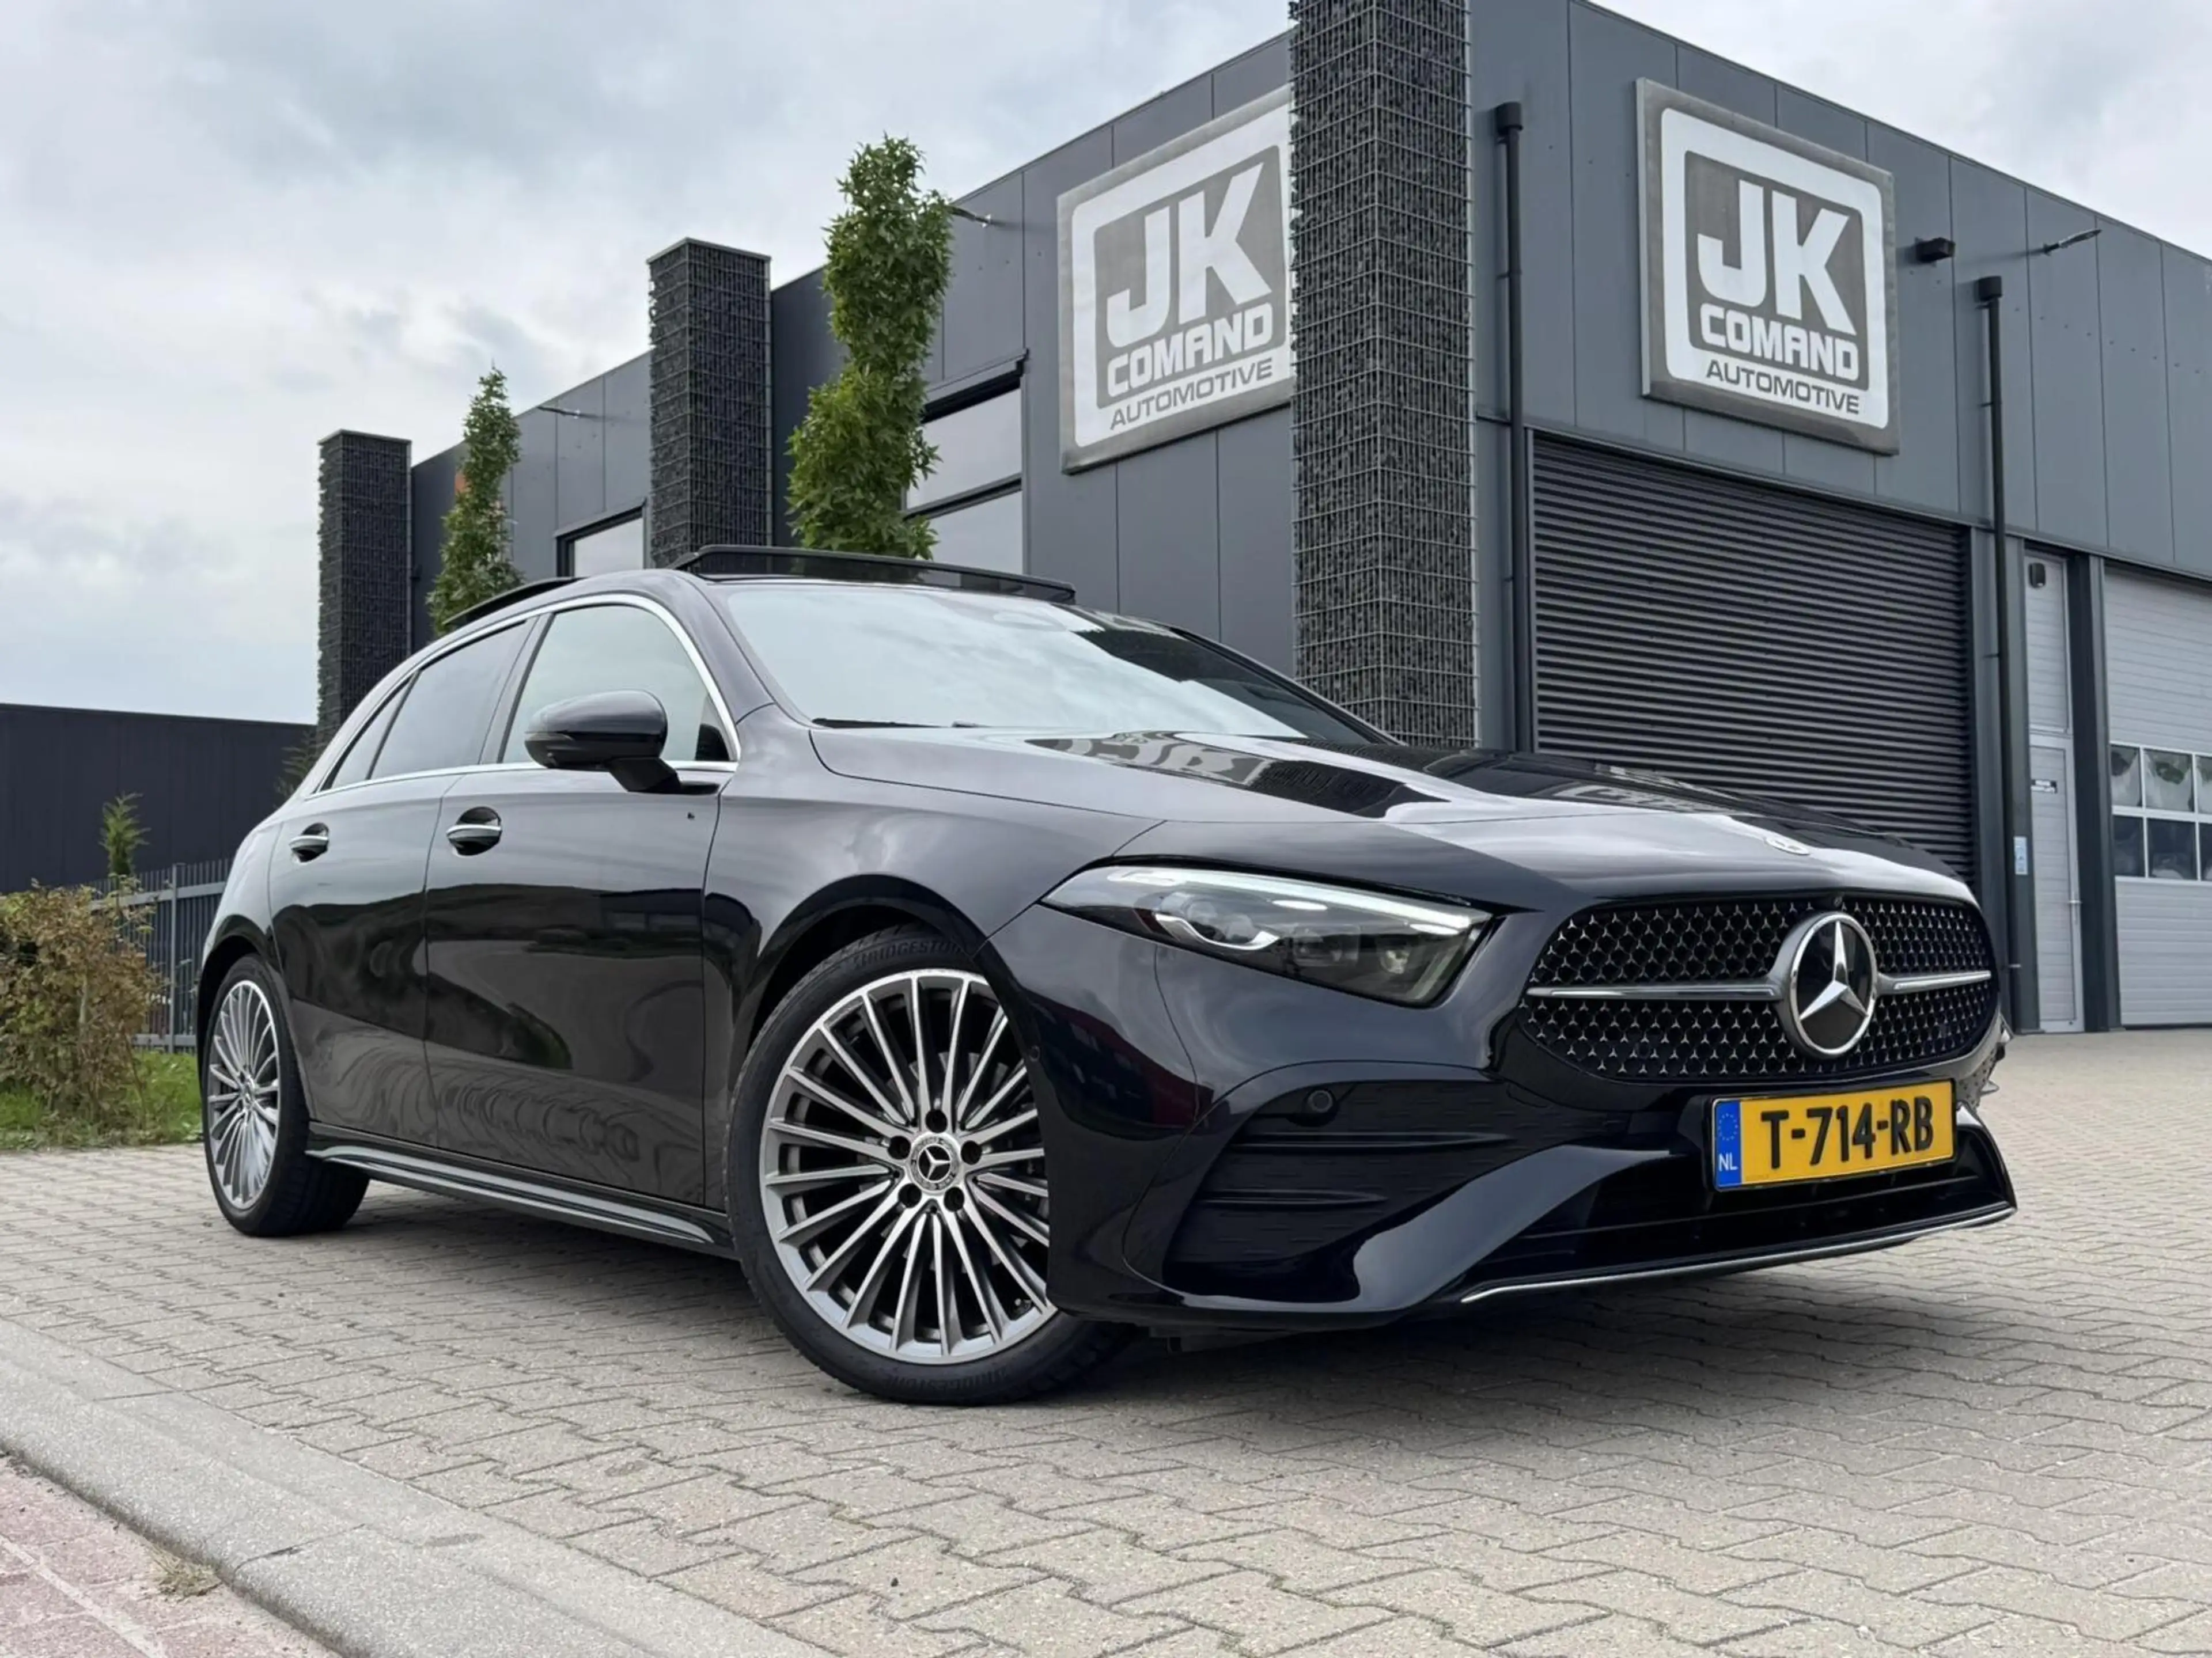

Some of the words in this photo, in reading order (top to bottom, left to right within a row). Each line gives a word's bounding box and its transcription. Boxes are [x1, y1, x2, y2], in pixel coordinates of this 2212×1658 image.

[1107, 162, 1272, 348] JK
[1697, 179, 1857, 336] JK
[1107, 302, 1272, 397] COMAND
[1700, 302, 1859, 381] COMAND
[1110, 357, 1272, 431] AUTOMOTIVE
[1706, 359, 1860, 415] AUTOMOTIVE
[1718, 1152, 1738, 1172] NL
[1760, 1095, 1933, 1170] T-714-RB
